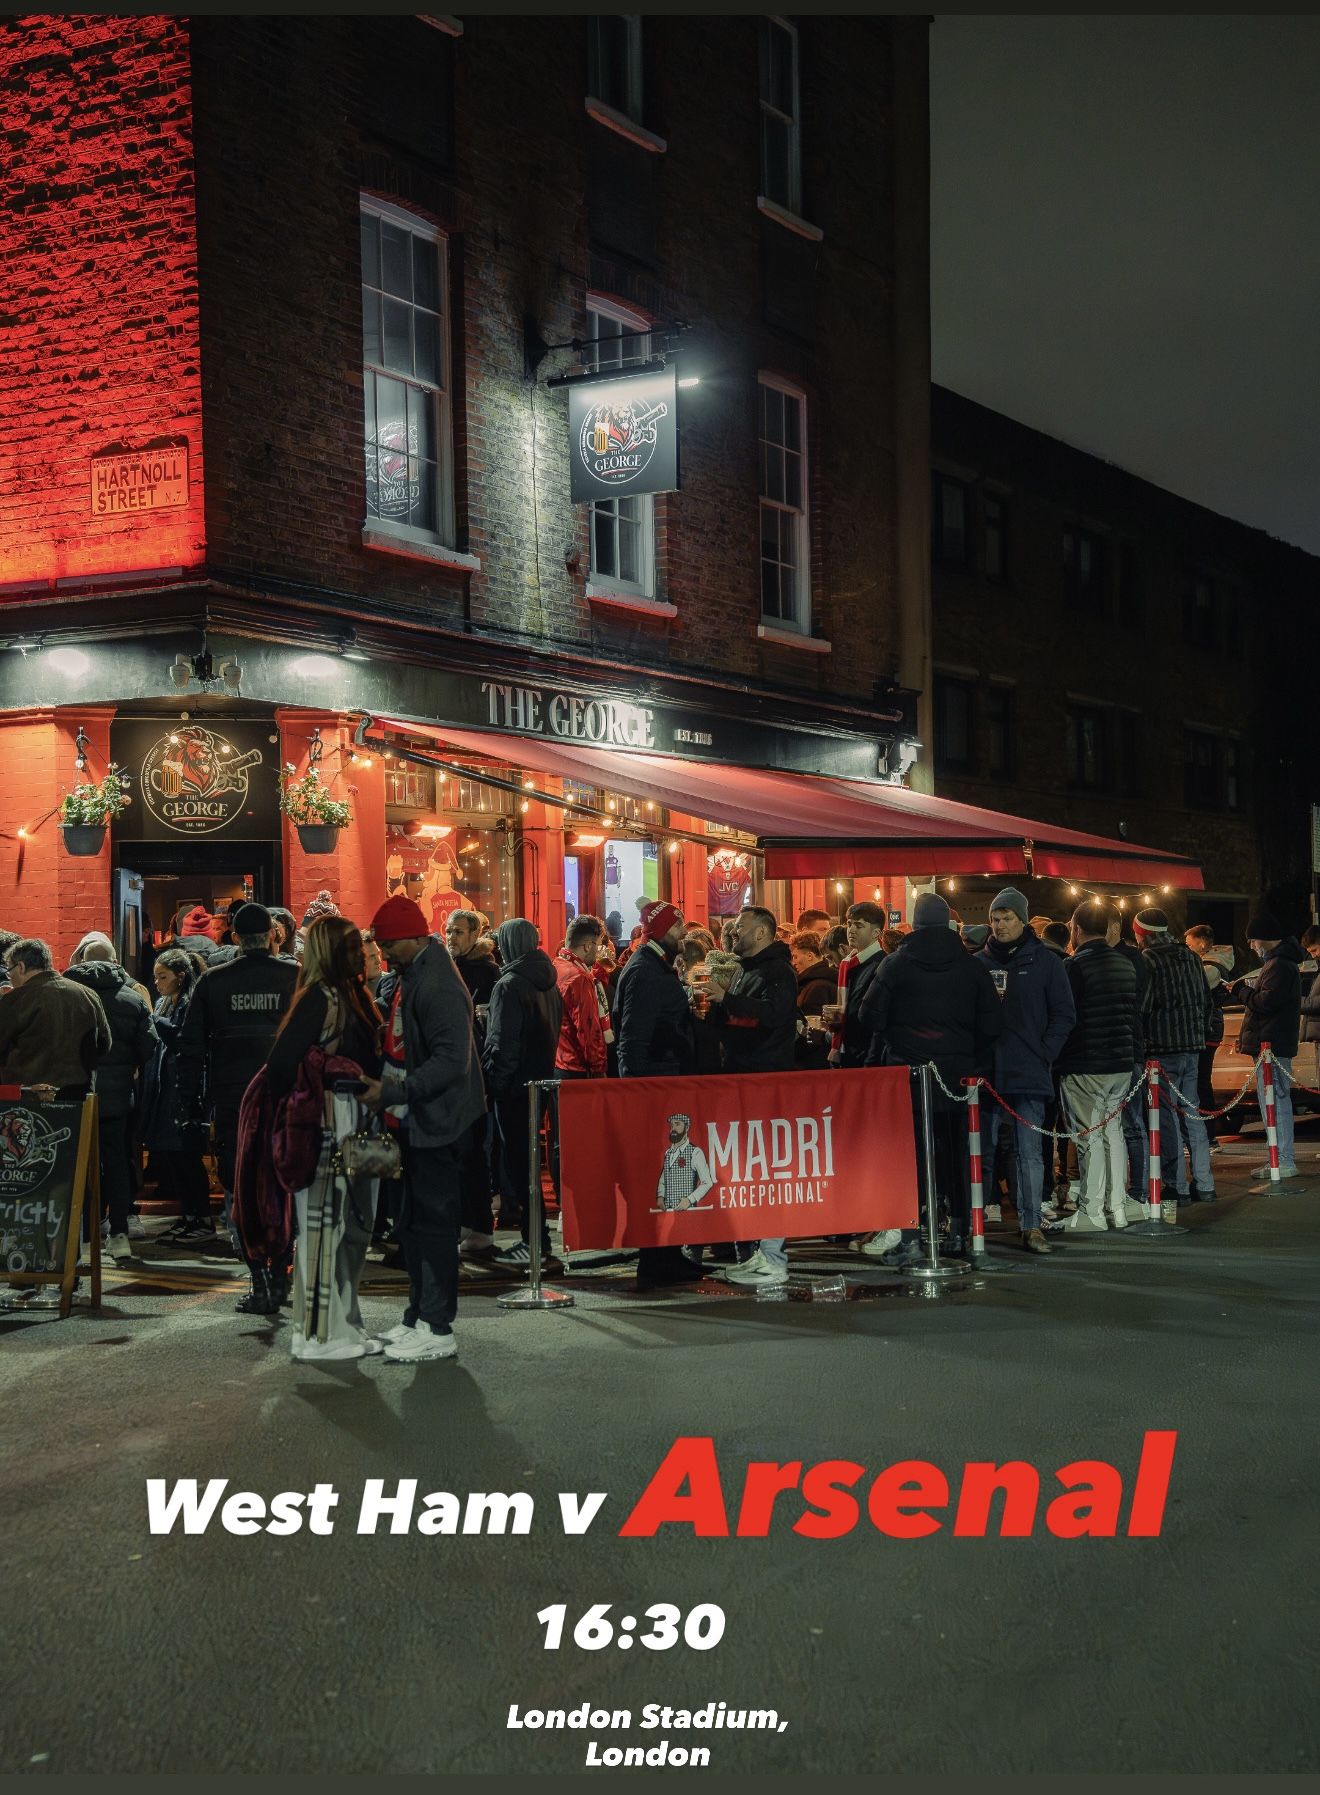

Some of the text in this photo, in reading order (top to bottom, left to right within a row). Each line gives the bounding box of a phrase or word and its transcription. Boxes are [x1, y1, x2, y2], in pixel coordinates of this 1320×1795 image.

[97, 460, 182, 490] HARTNOLL
[594, 454, 642, 472] GEORGE
[97, 484, 157, 512] STREET
[481, 682, 543, 731] THE
[549, 694, 655, 748] GEORGE
[162, 801, 228, 817] GEORGE
[719, 882, 739, 892] JVC
[231, 993, 280, 1011] SECURITY
[706, 1105, 835, 1184] MADRÍ
[720, 1181, 824, 1209] EXCEPCIONAL
